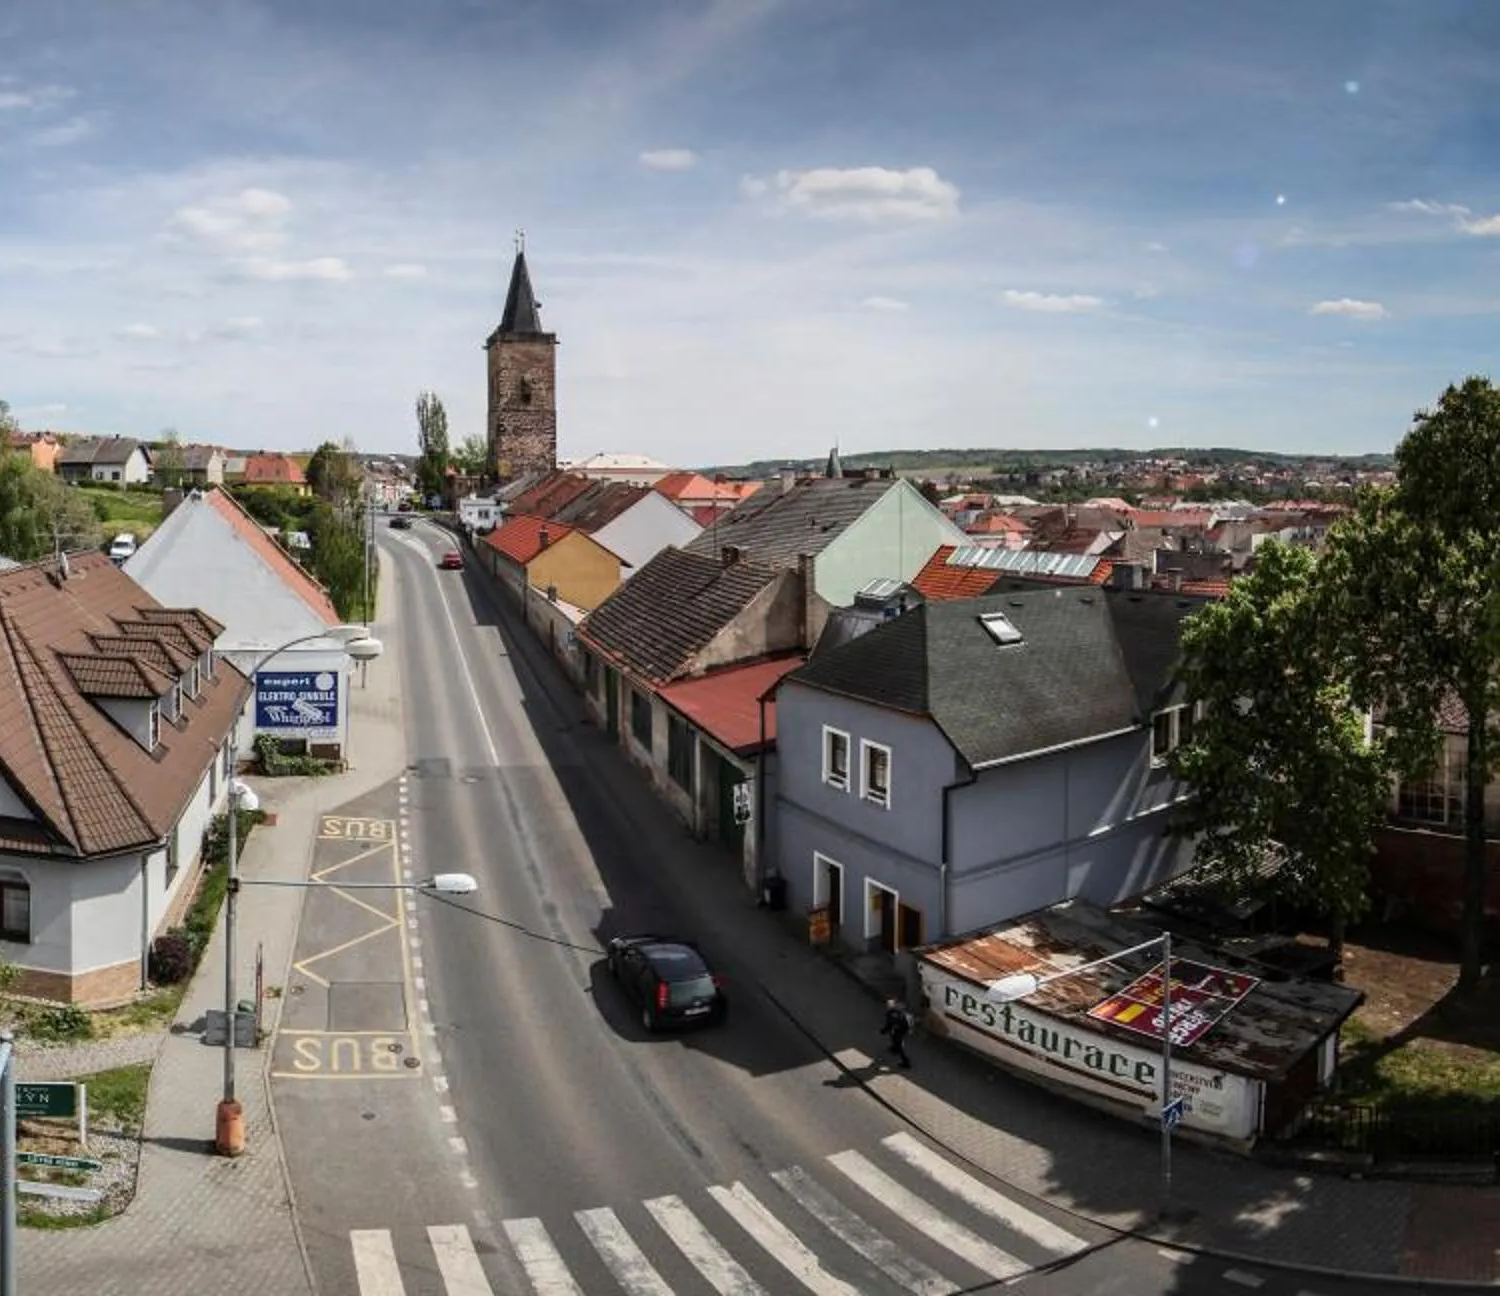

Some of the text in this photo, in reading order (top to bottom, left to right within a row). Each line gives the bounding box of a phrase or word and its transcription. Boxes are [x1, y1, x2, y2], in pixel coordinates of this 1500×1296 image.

[267, 711, 331, 725] Whirlpl
[323, 819, 386, 839] BUS
[944, 985, 1157, 1085] restaurace
[293, 1037, 398, 1071] BUS
